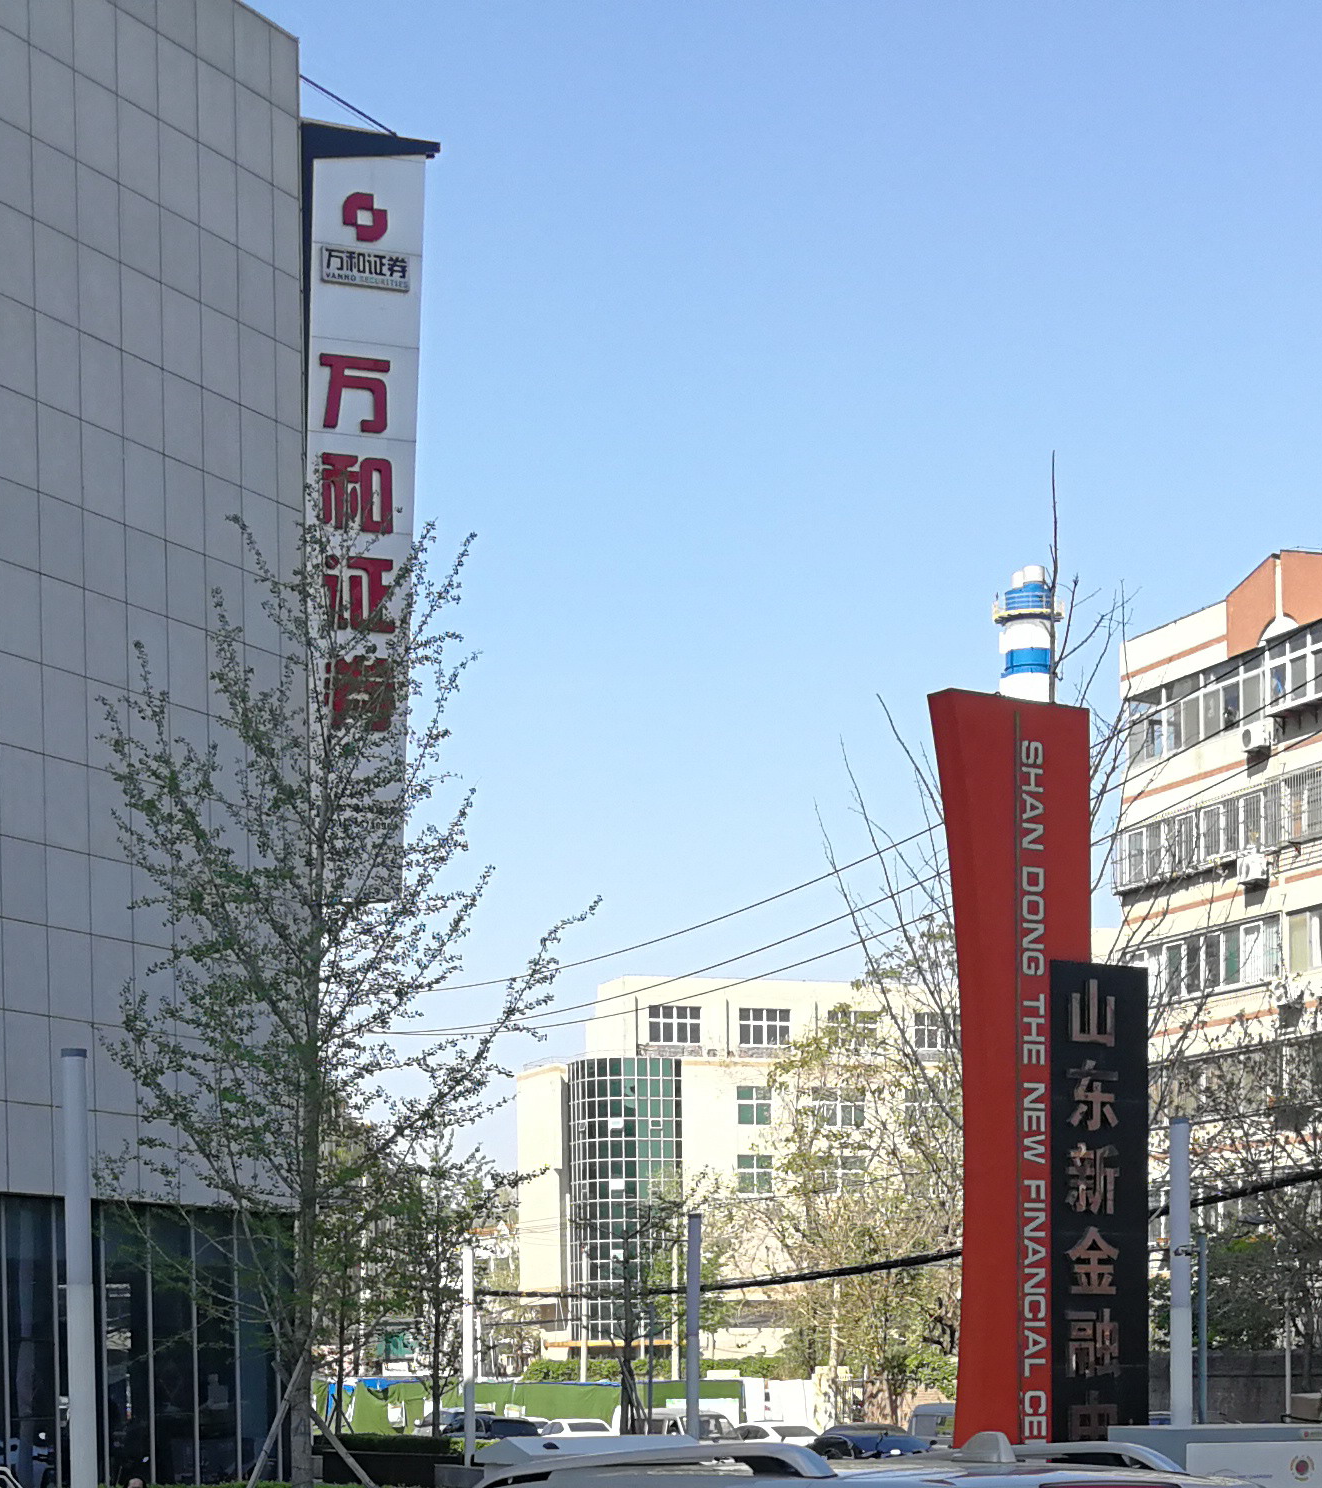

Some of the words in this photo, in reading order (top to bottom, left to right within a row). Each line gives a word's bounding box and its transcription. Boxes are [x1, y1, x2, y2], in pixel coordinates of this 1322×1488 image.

[325, 247, 408, 279] 万和证券
[1021, 740, 1044, 851] SHAN
[1021, 866, 1045, 976] DONG
[1022, 994, 1046, 1065] THE
[1023, 1082, 1047, 1164] NEW
[1023, 1179, 1048, 1377] FINANCIAL
